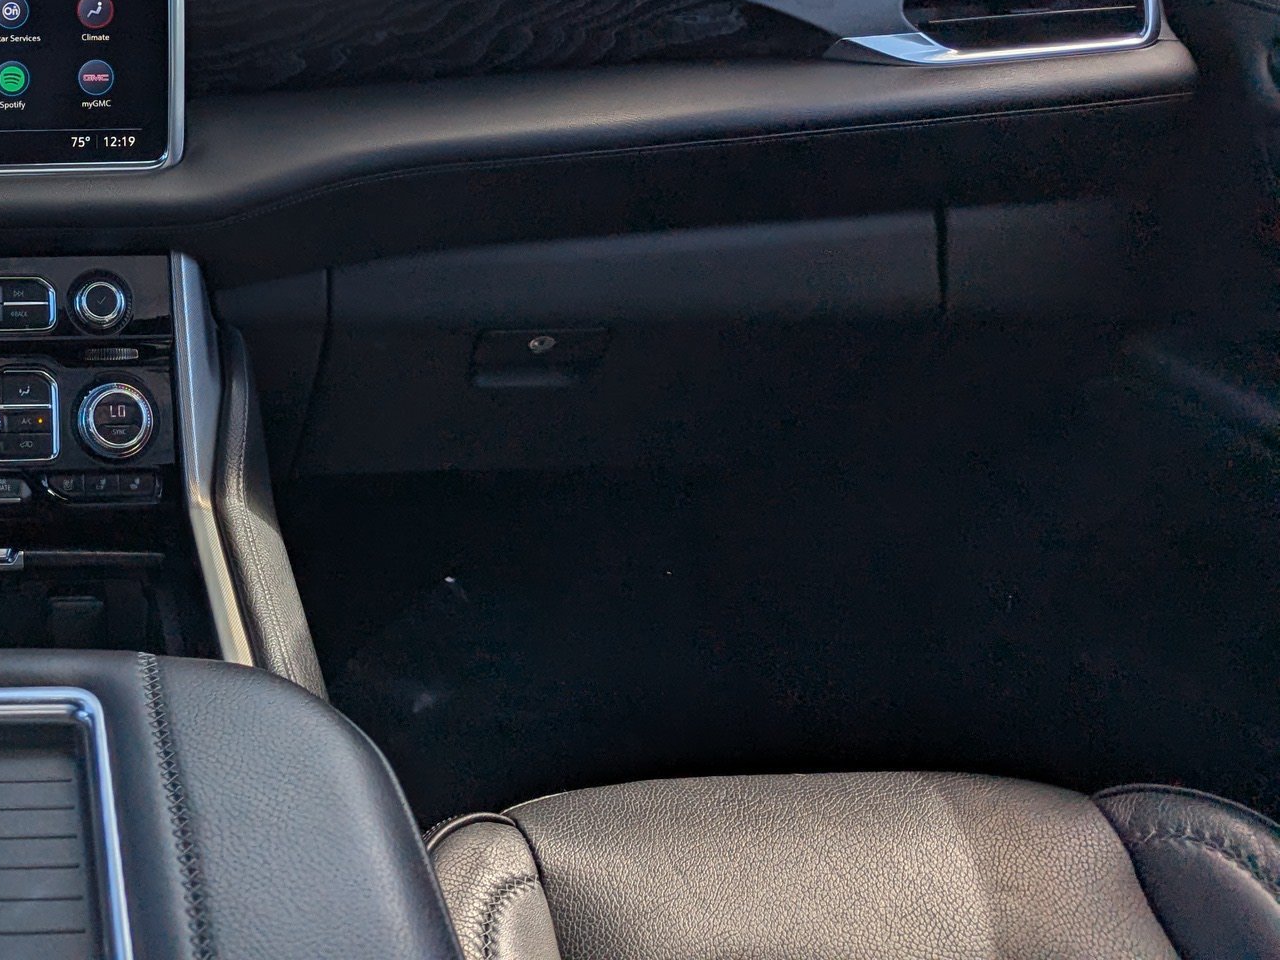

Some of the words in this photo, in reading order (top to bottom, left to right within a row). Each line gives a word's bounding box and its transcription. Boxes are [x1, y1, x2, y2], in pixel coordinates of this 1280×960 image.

[10, 34, 41, 43] Services
[81, 33, 110, 42] Climate
[82, 73, 110, 82] GMC
[0, 101, 26, 111] Spotify
[81, 99, 111, 109] myGMC
[71, 136, 91, 148] 75°
[104, 135, 136, 147] 12:19
[109, 404, 126, 418] LO
